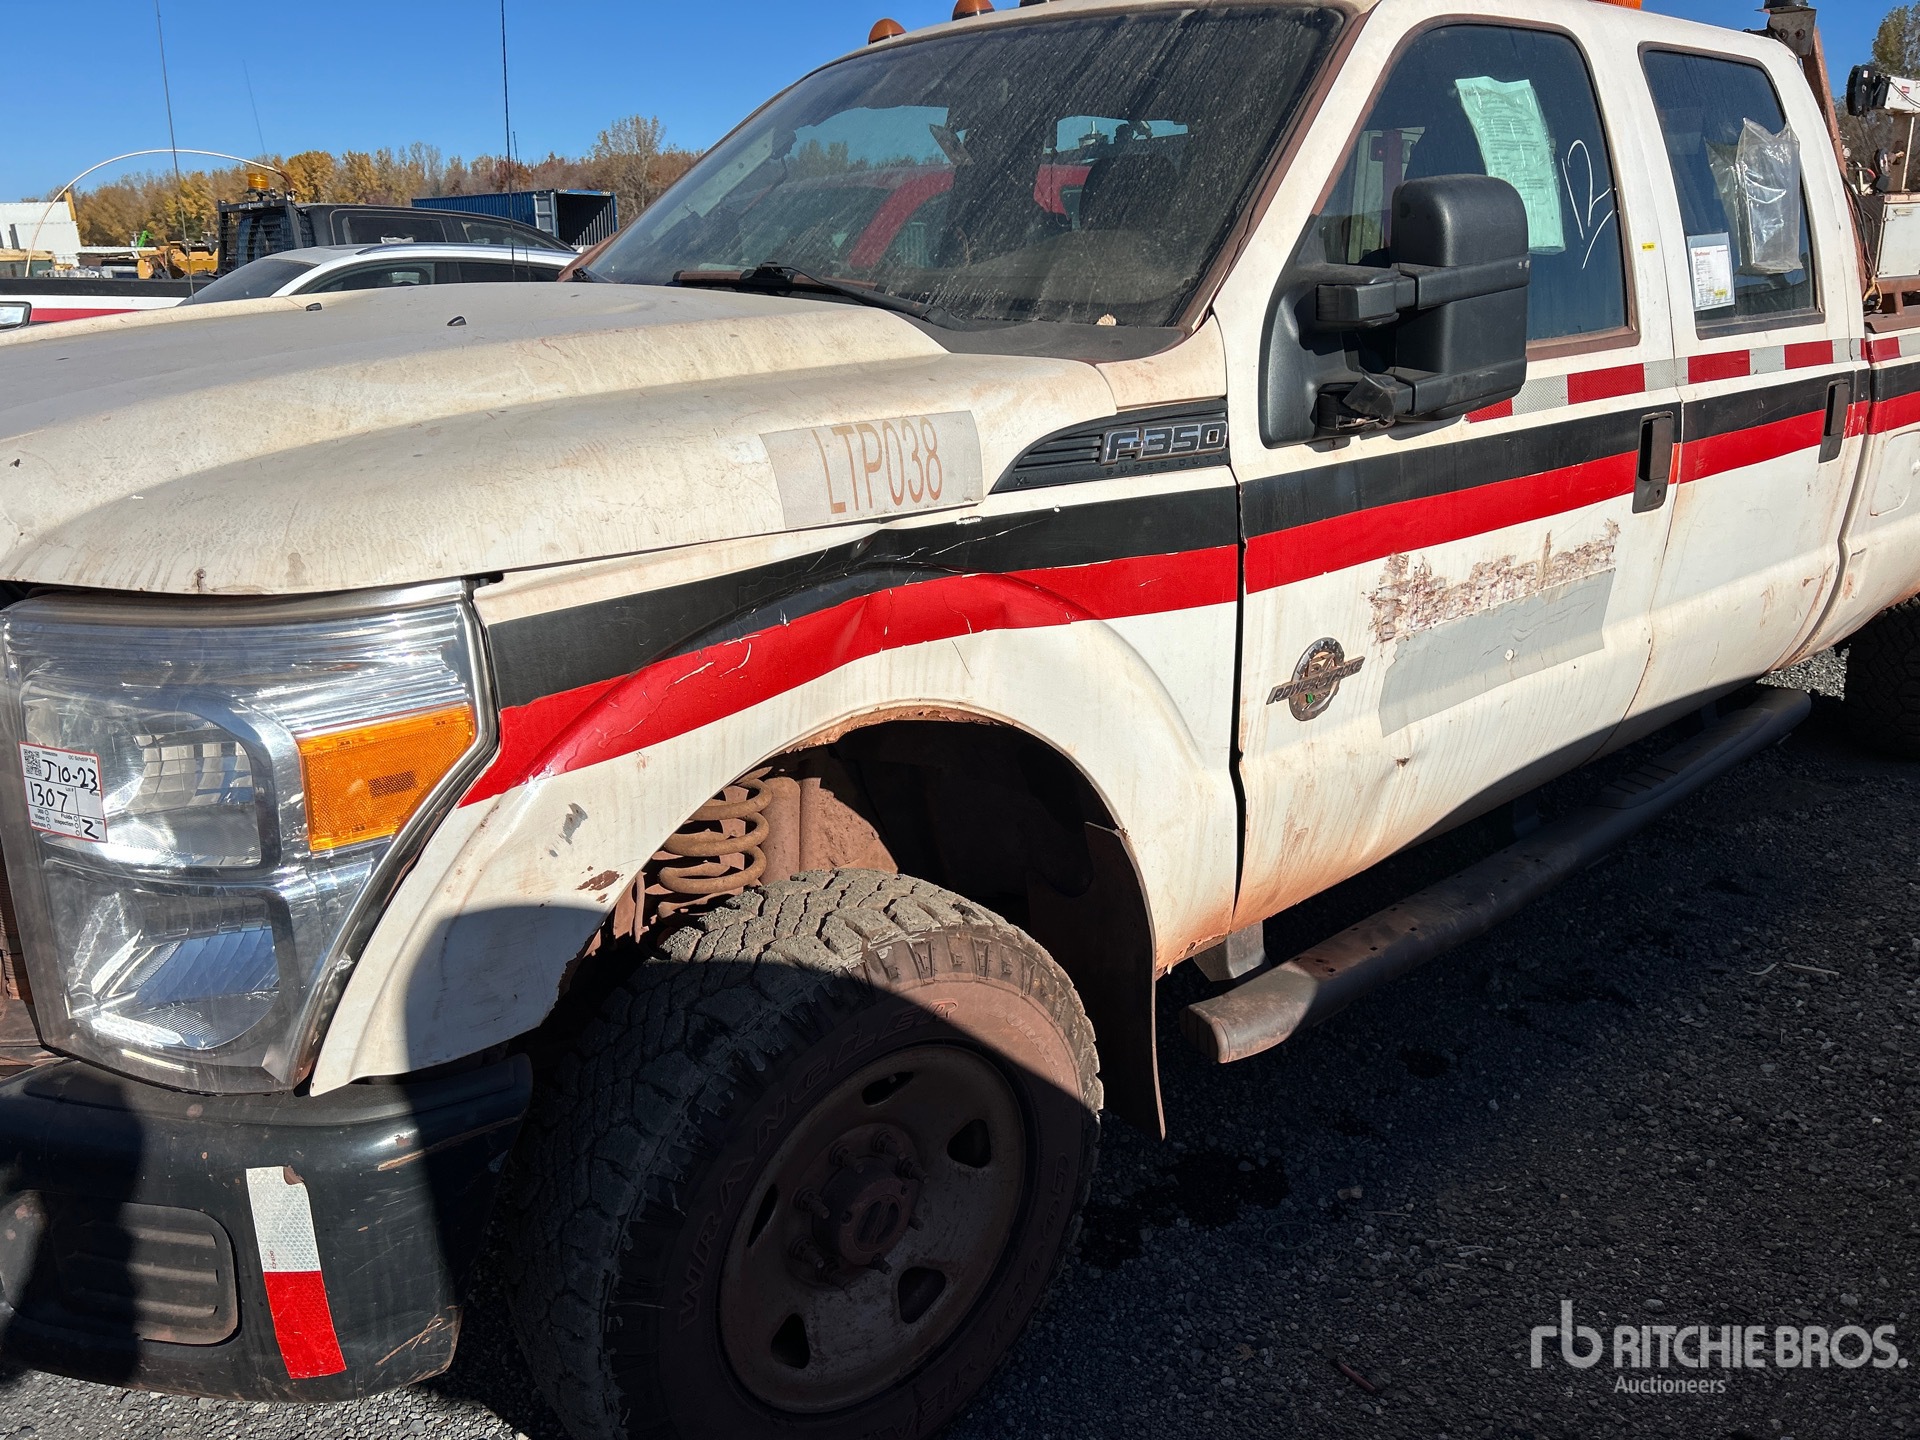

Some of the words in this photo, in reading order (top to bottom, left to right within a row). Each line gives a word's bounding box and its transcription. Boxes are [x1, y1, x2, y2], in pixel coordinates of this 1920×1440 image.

[812, 416, 944, 514] LTP038
[1106, 461, 1168, 475] SUPER
[1178, 454, 1224, 467] DUTY
[1015, 476, 1030, 487] XL
[42, 759, 98, 794] J10-23
[30, 781, 68, 812] 1307
[677, 995, 959, 1334] WRANGLER
